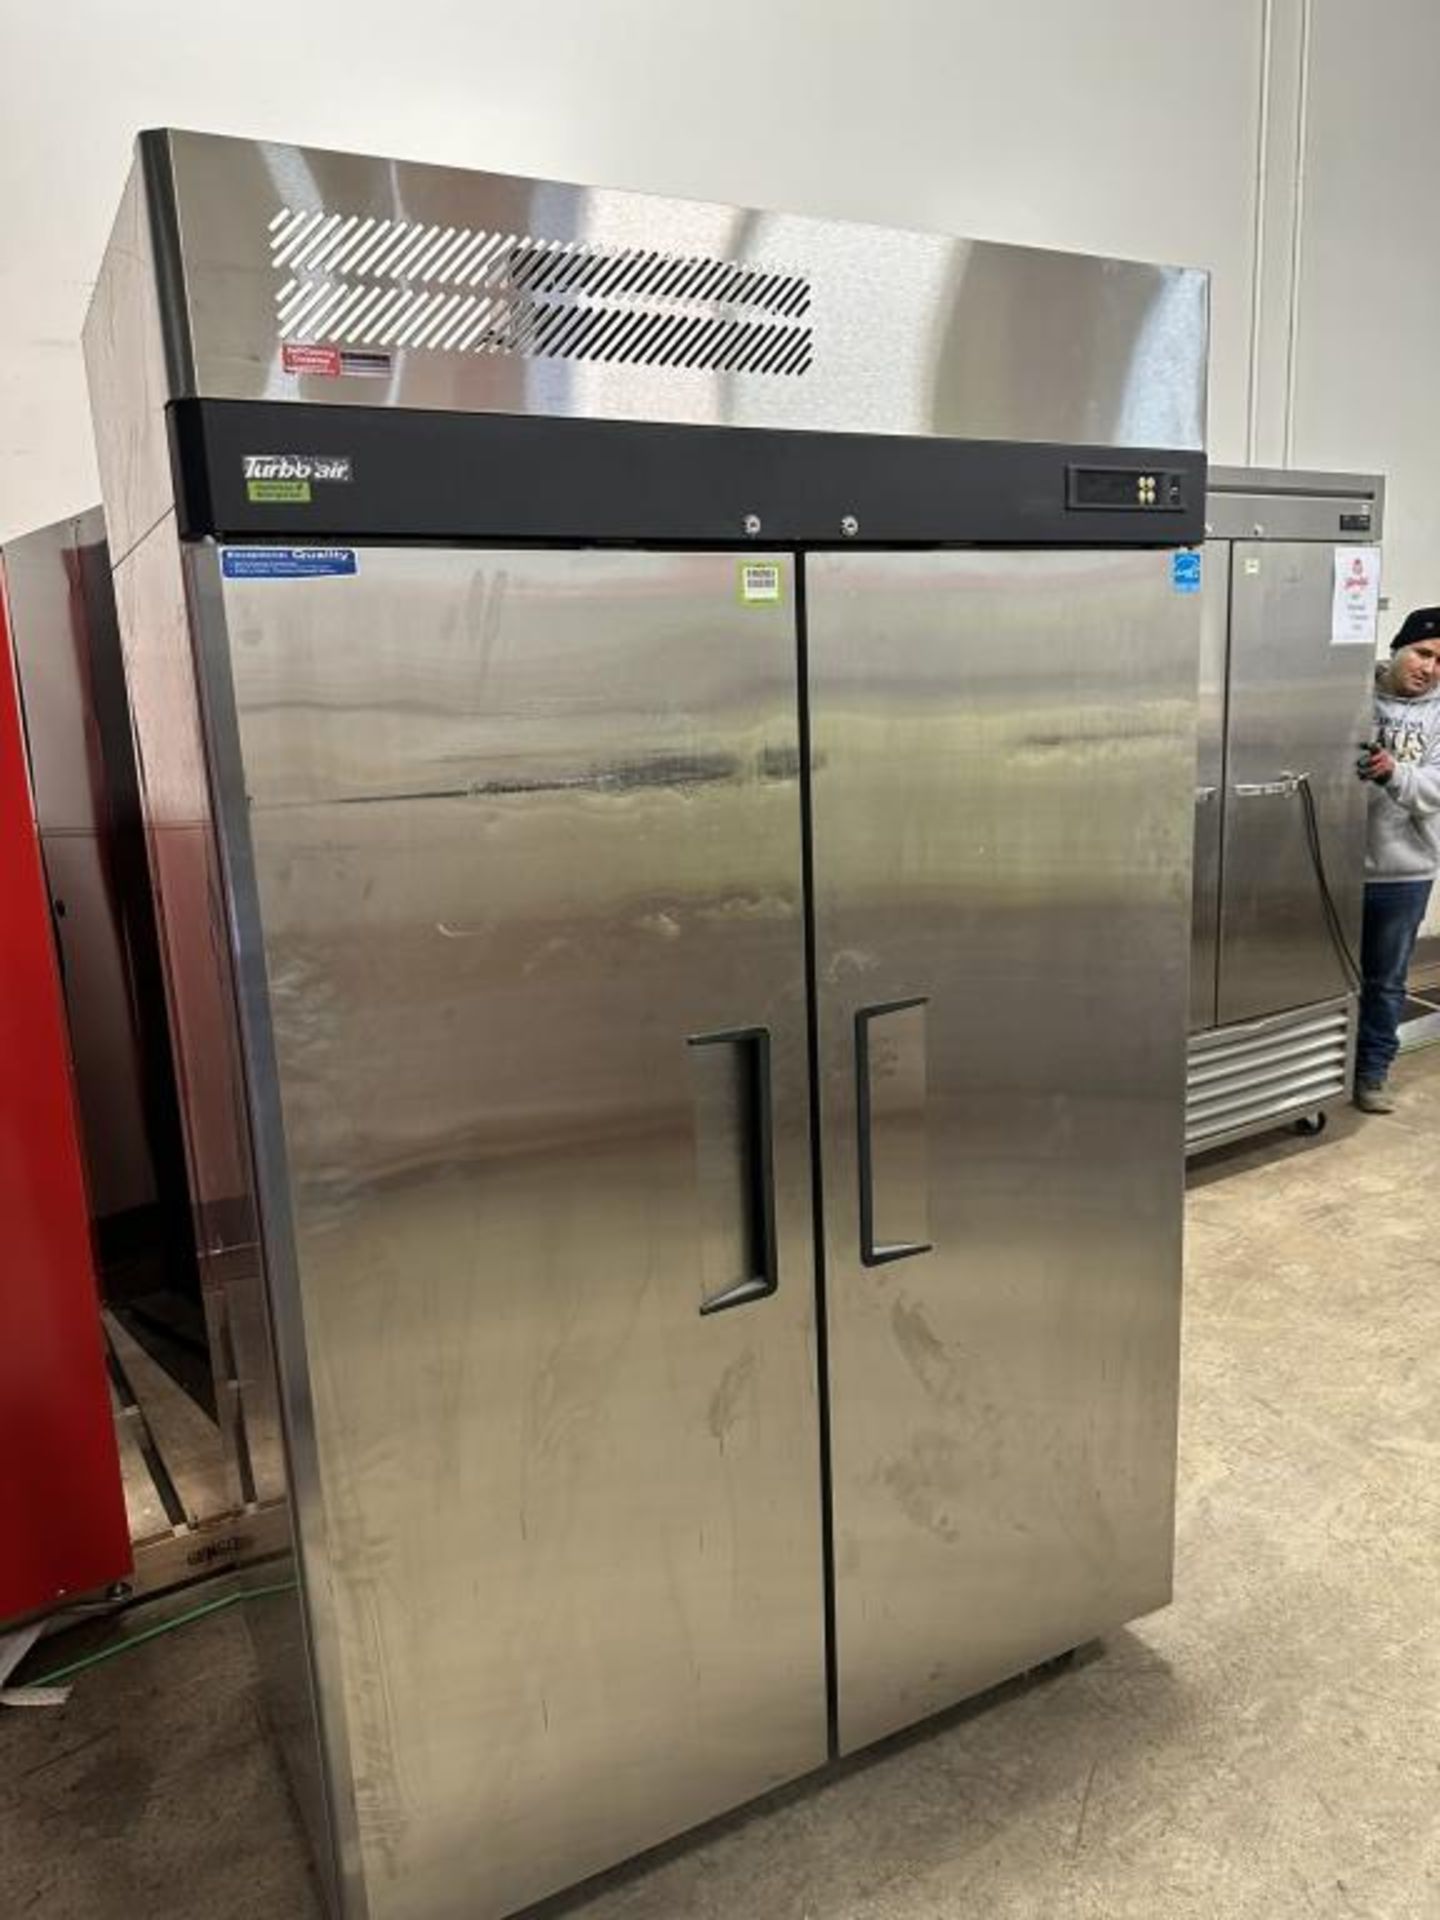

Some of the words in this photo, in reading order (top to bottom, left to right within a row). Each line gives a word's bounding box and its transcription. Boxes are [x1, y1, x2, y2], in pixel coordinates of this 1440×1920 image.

[243, 456, 311, 478] Turbo
[314, 460, 348, 479] air
[291, 549, 349, 561] Quality
